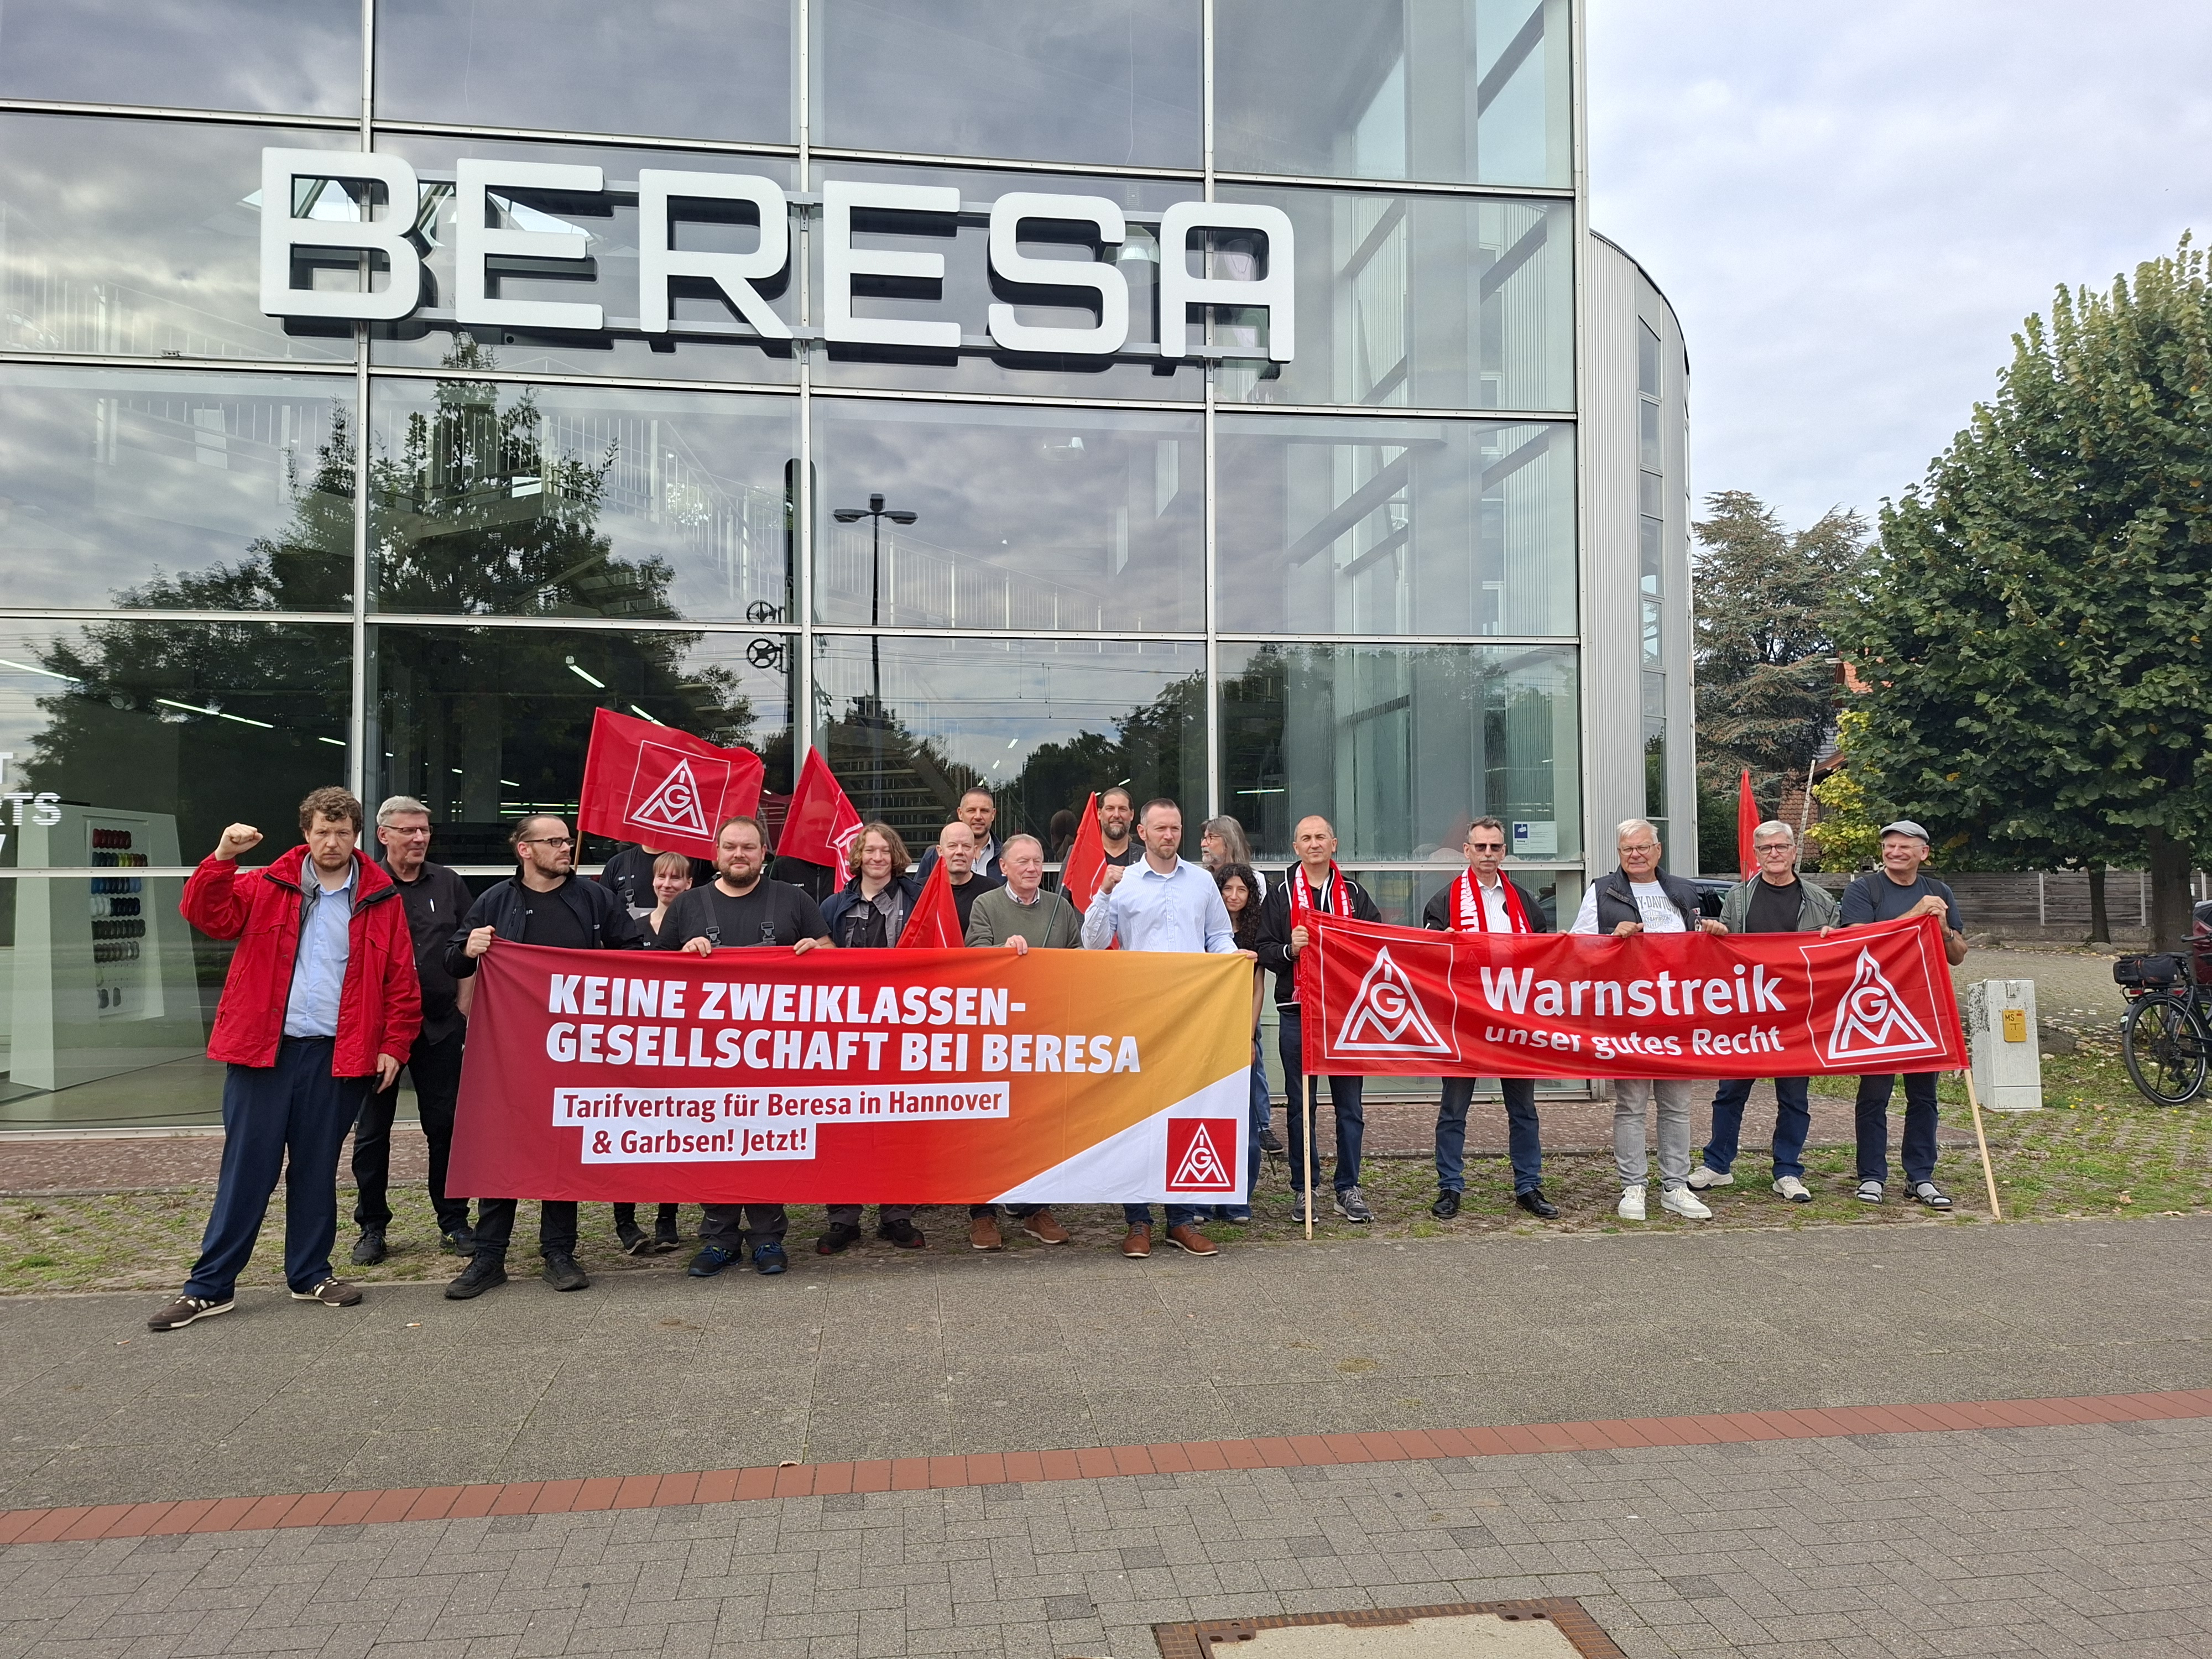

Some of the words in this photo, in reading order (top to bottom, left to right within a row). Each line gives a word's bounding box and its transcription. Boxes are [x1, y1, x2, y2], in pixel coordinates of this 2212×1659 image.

[260, 147, 1294, 362] BERESA
[549, 973, 687, 1019] KEINE
[698, 982, 1026, 1026] ZWEIKLASSEN-
[1480, 964, 1786, 1017] Warnstreik
[2005, 1013, 2015, 1021] MS
[546, 1021, 889, 1071] GESELLSCHAFT
[900, 1032, 968, 1072] BEI
[982, 1034, 1141, 1073] BERESA
[1485, 1026, 1581, 1052] unser
[1591, 1031, 1682, 1060] gutes
[1693, 1025, 1785, 1055] Recht
[563, 1093, 717, 1123] Tarifvertrag
[723, 1093, 760, 1117] für
[768, 1093, 852, 1116] Beresa
[859, 1090, 880, 1115] in
[888, 1090, 1002, 1114] Hannover
[592, 1130, 612, 1154] &
[620, 1128, 734, 1154] Garbsen!
[740, 1128, 807, 1157] Jetzt!
